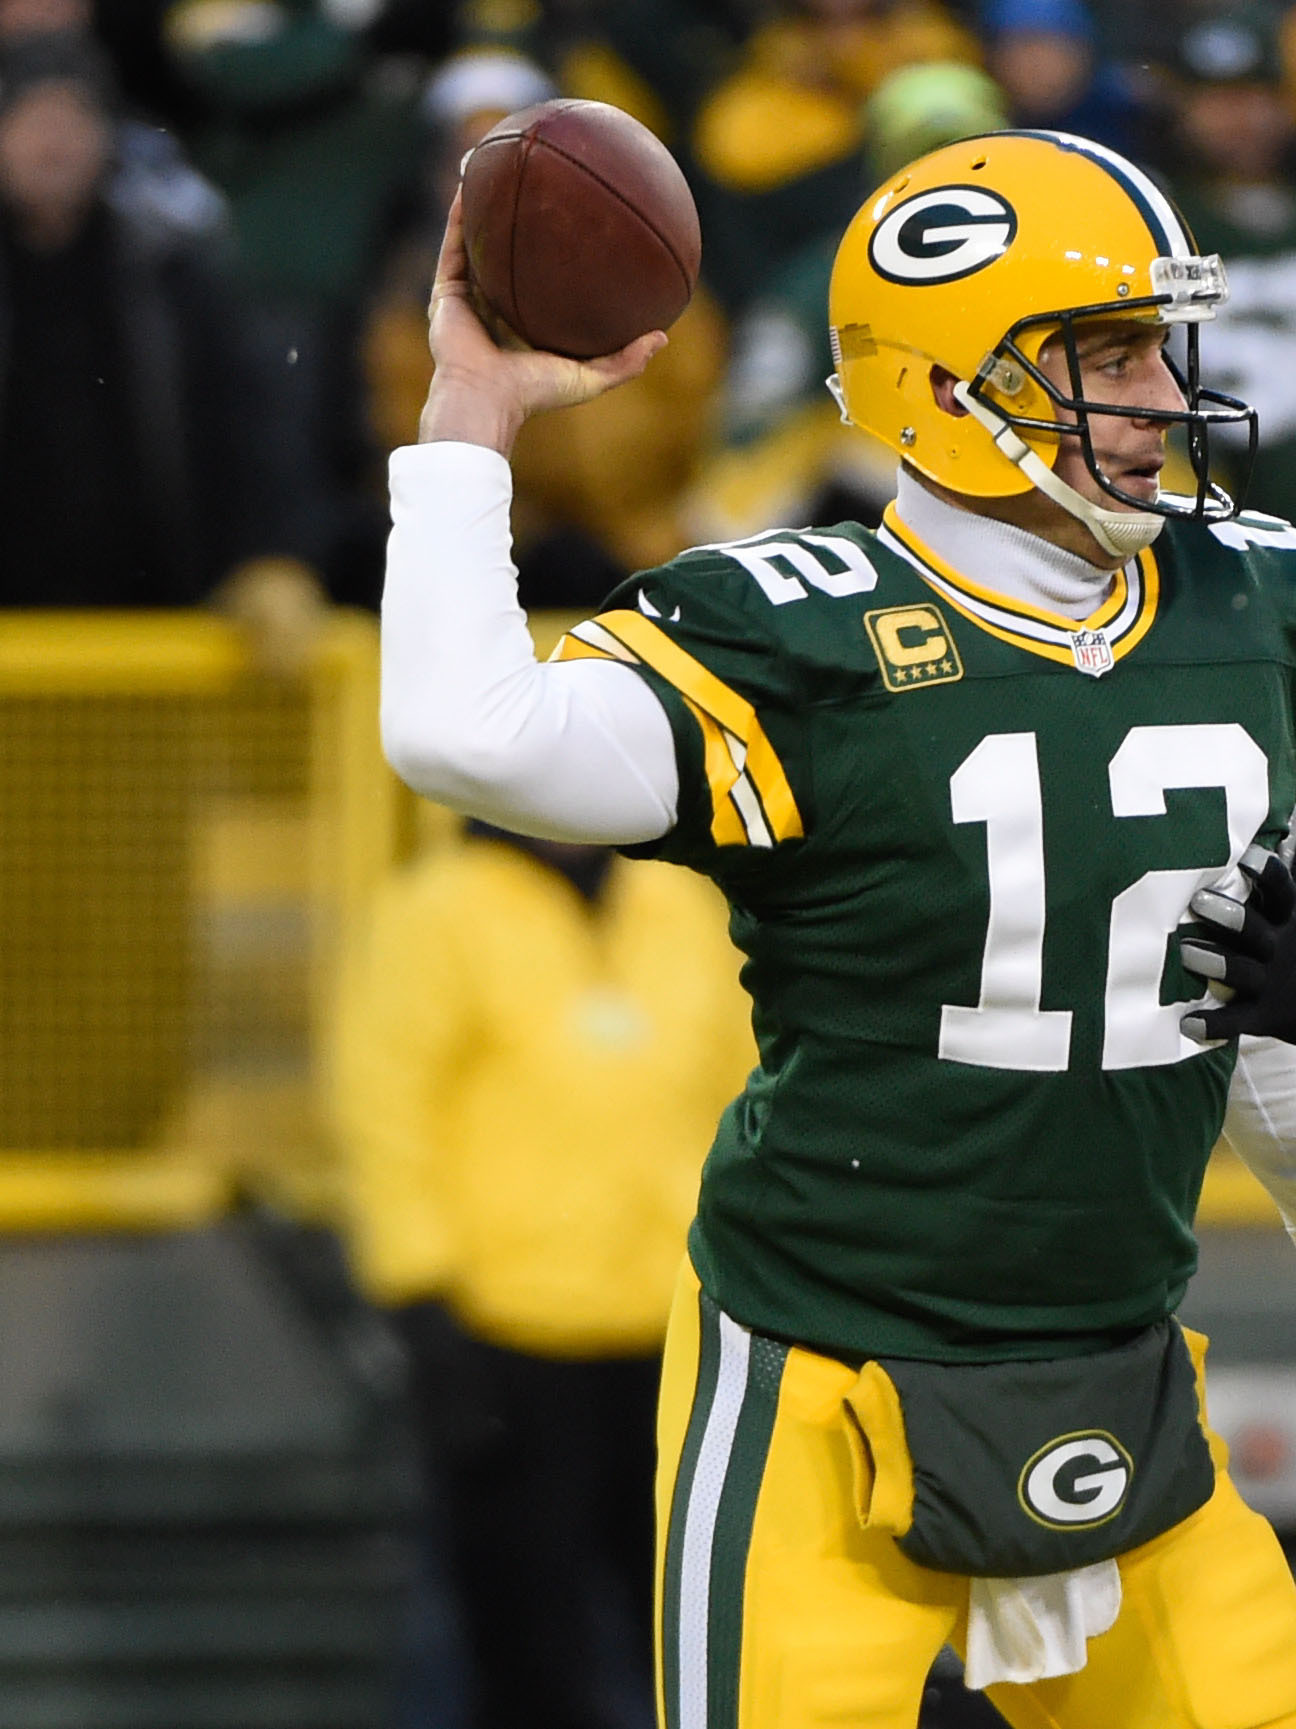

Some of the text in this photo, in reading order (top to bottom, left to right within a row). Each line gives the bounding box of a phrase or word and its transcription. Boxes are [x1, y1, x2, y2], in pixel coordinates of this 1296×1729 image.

[872, 188, 1012, 279] G
[678, 526, 879, 606] 2
[875, 609, 948, 668] C
[1080, 647, 1108, 668] NFL
[938, 722, 1270, 1072] 12
[1027, 1437, 1127, 1522] G
